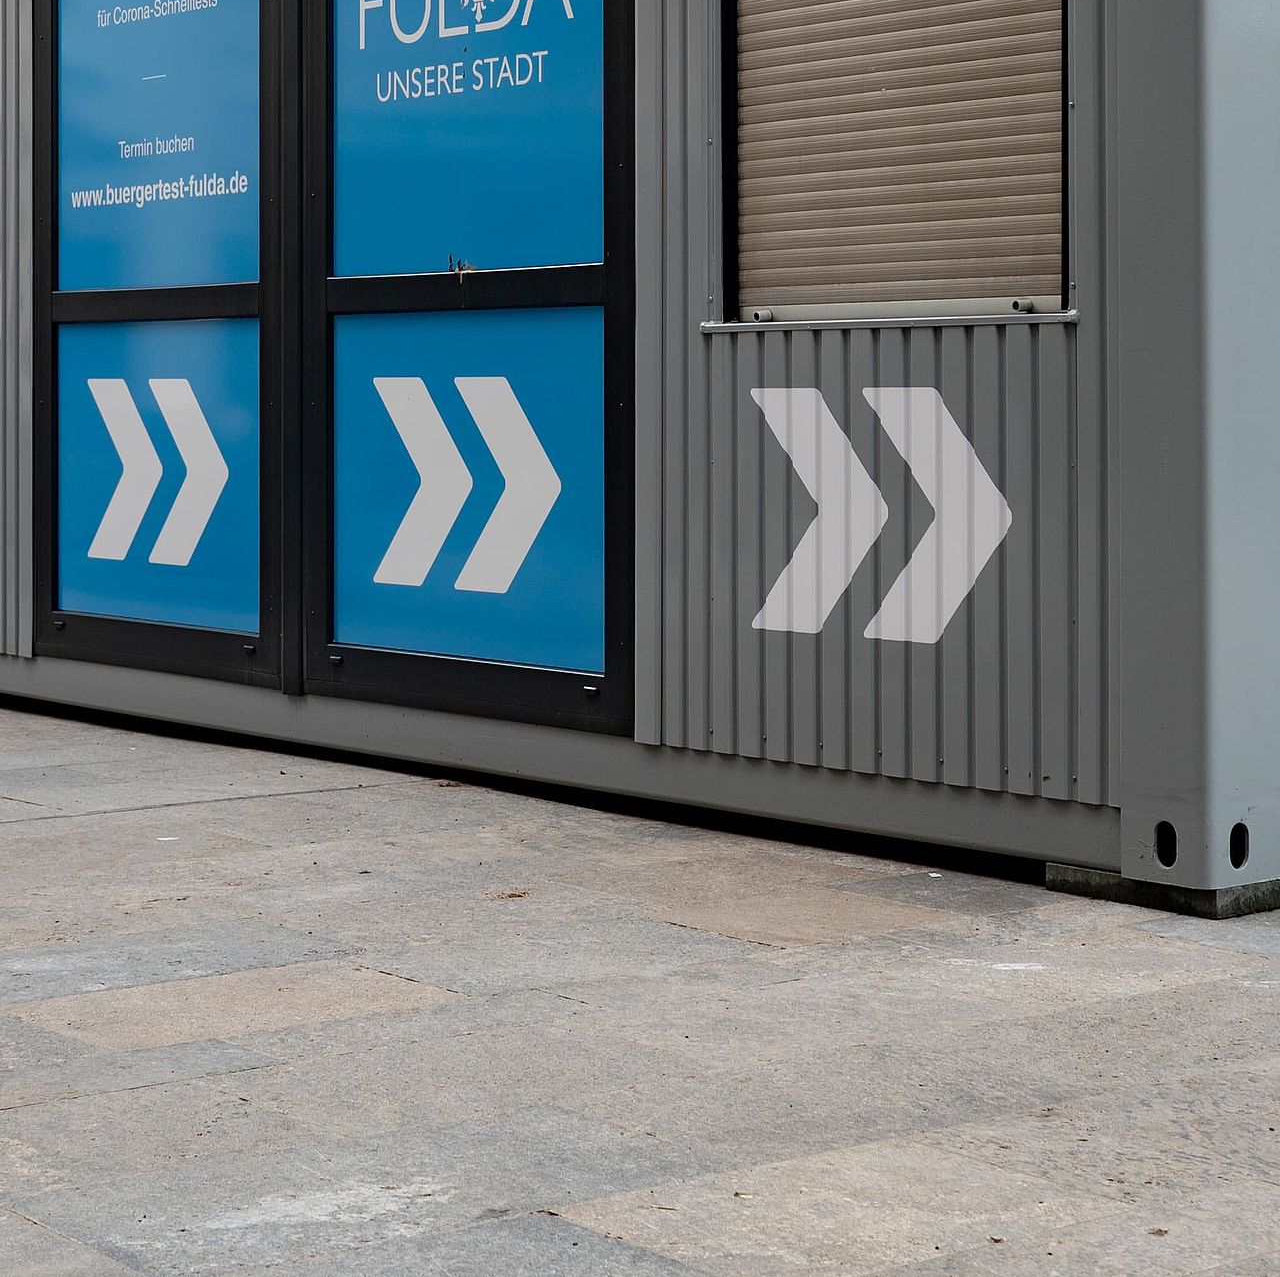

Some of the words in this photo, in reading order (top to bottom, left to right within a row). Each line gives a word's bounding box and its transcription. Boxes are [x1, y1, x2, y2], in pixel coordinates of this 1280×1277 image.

[97, 9, 111, 27] für
[377, 61, 464, 103] UNSERE
[472, 50, 549, 91] STADT
[118, 138, 153, 159] Termin
[156, 134, 195, 155] buchen
[71, 170, 248, 208] www.buergertest-fulda.de
